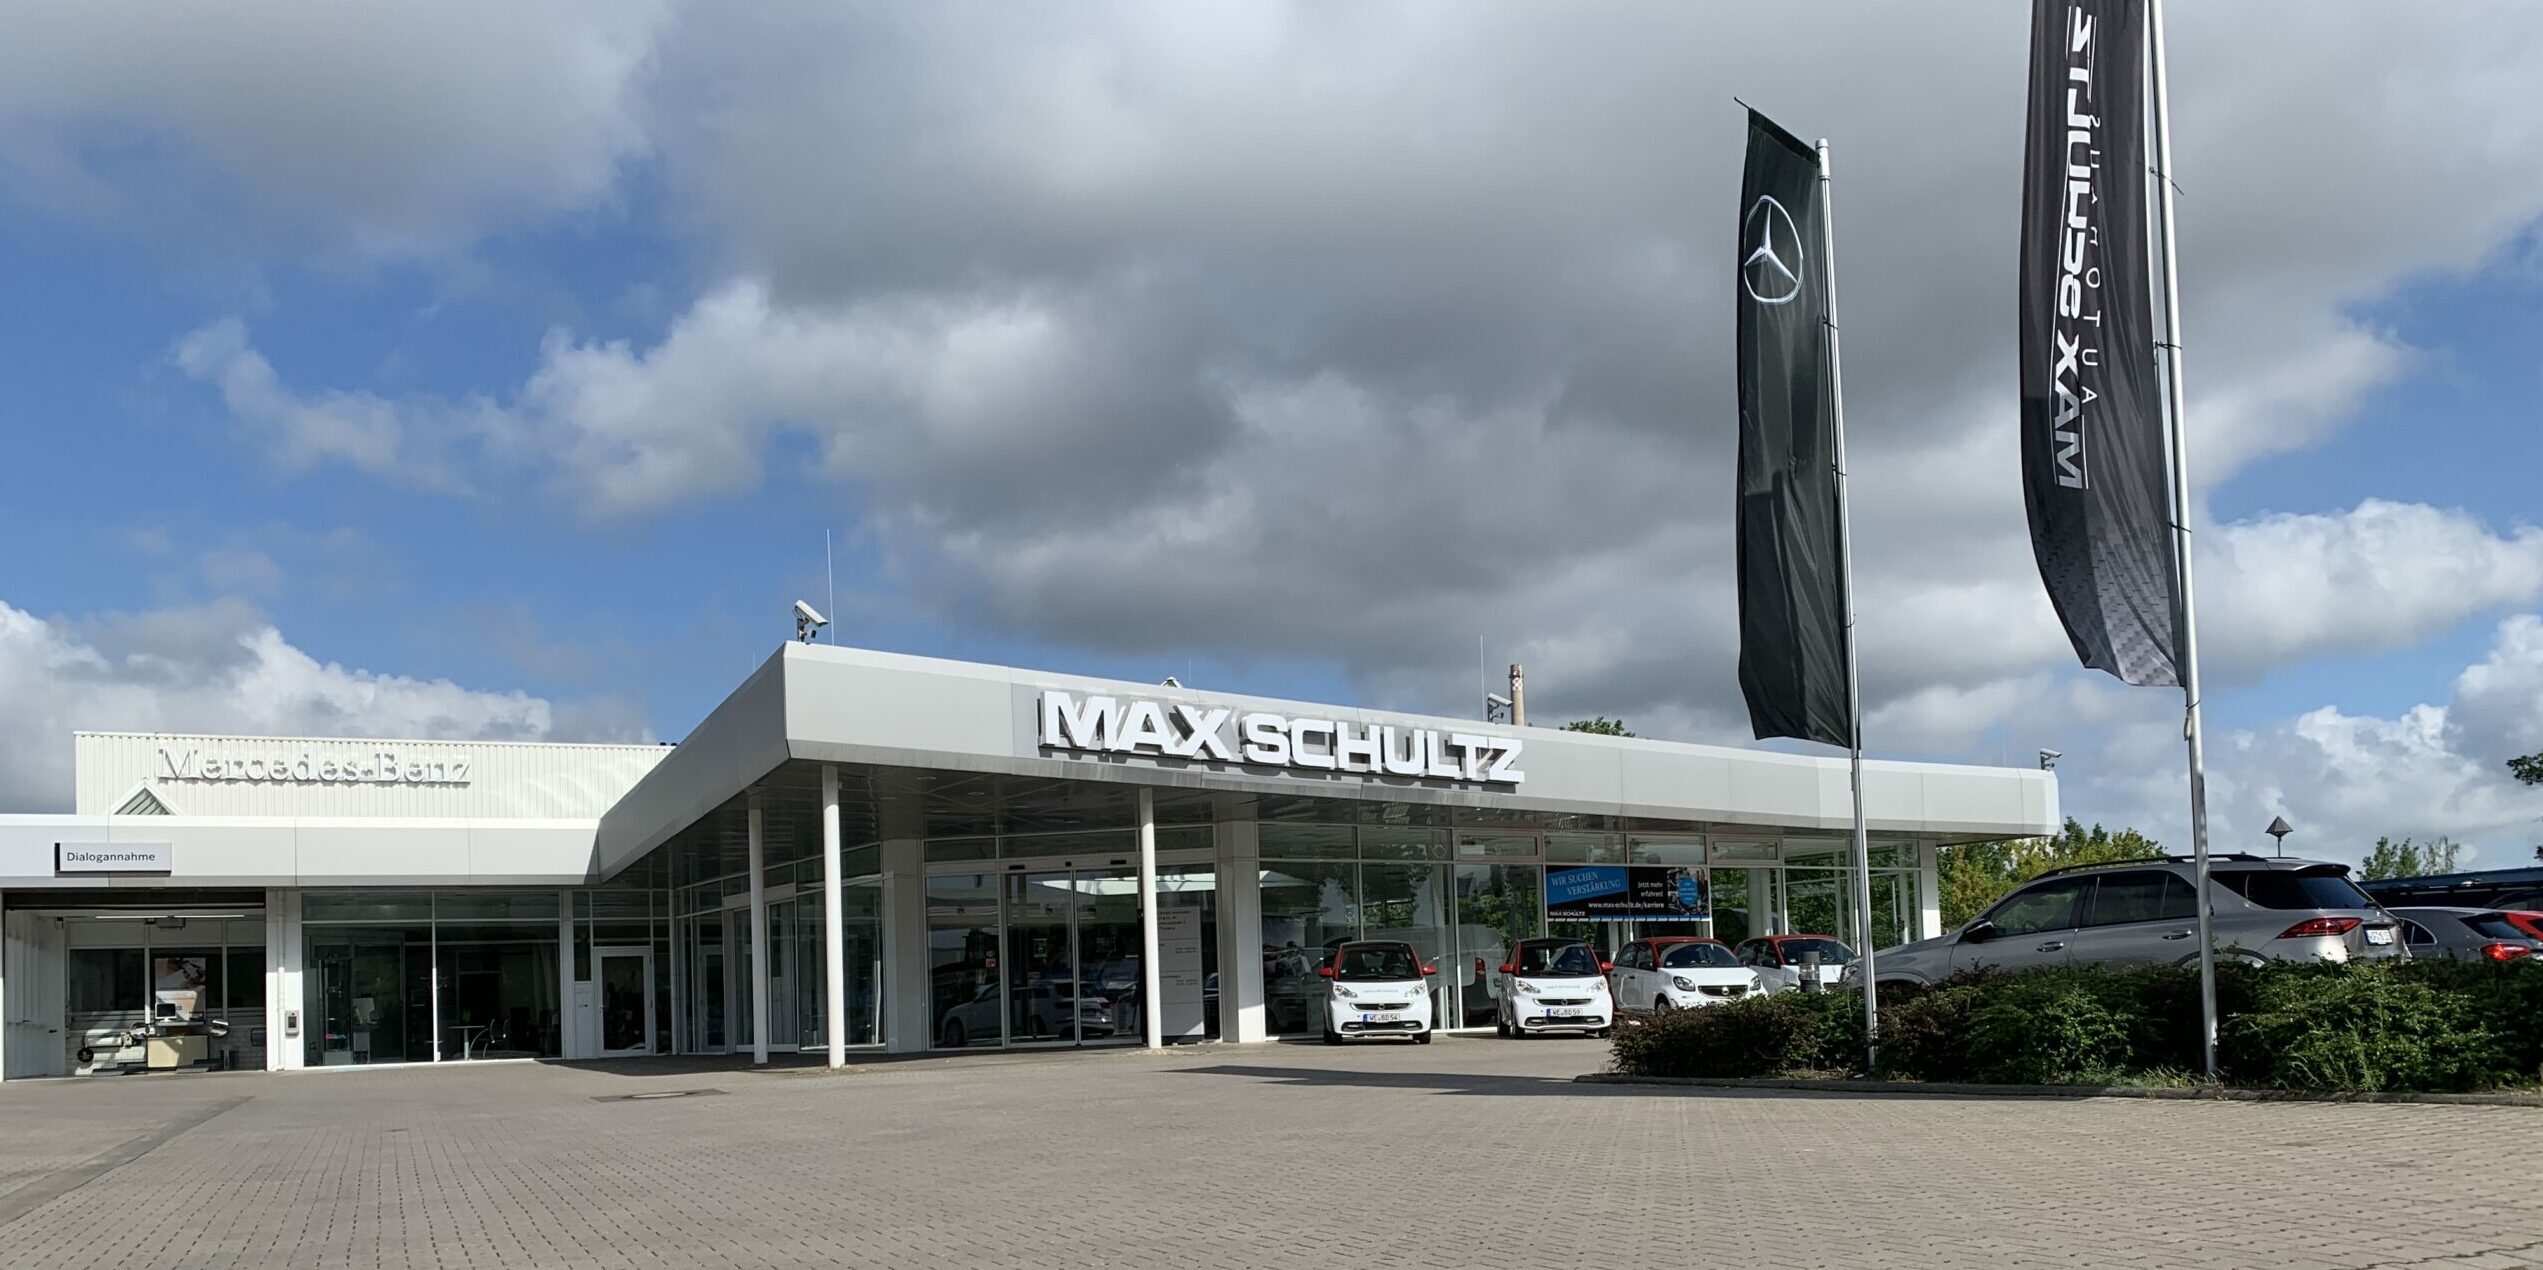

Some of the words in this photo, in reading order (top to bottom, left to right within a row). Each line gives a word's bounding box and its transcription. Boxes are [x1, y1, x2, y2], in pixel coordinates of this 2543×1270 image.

[1040, 690, 1233, 760] MAX
[1241, 712, 1526, 784] SCHULTZ
[158, 748, 470, 784] Mercedes-Benz
[66, 851, 156, 864] Dialogannahme
[1551, 876, 1566, 886] WIR
[1567, 871, 1598, 884] SUCHEN
[1567, 879, 1621, 895] VERSTÄRKUNG
